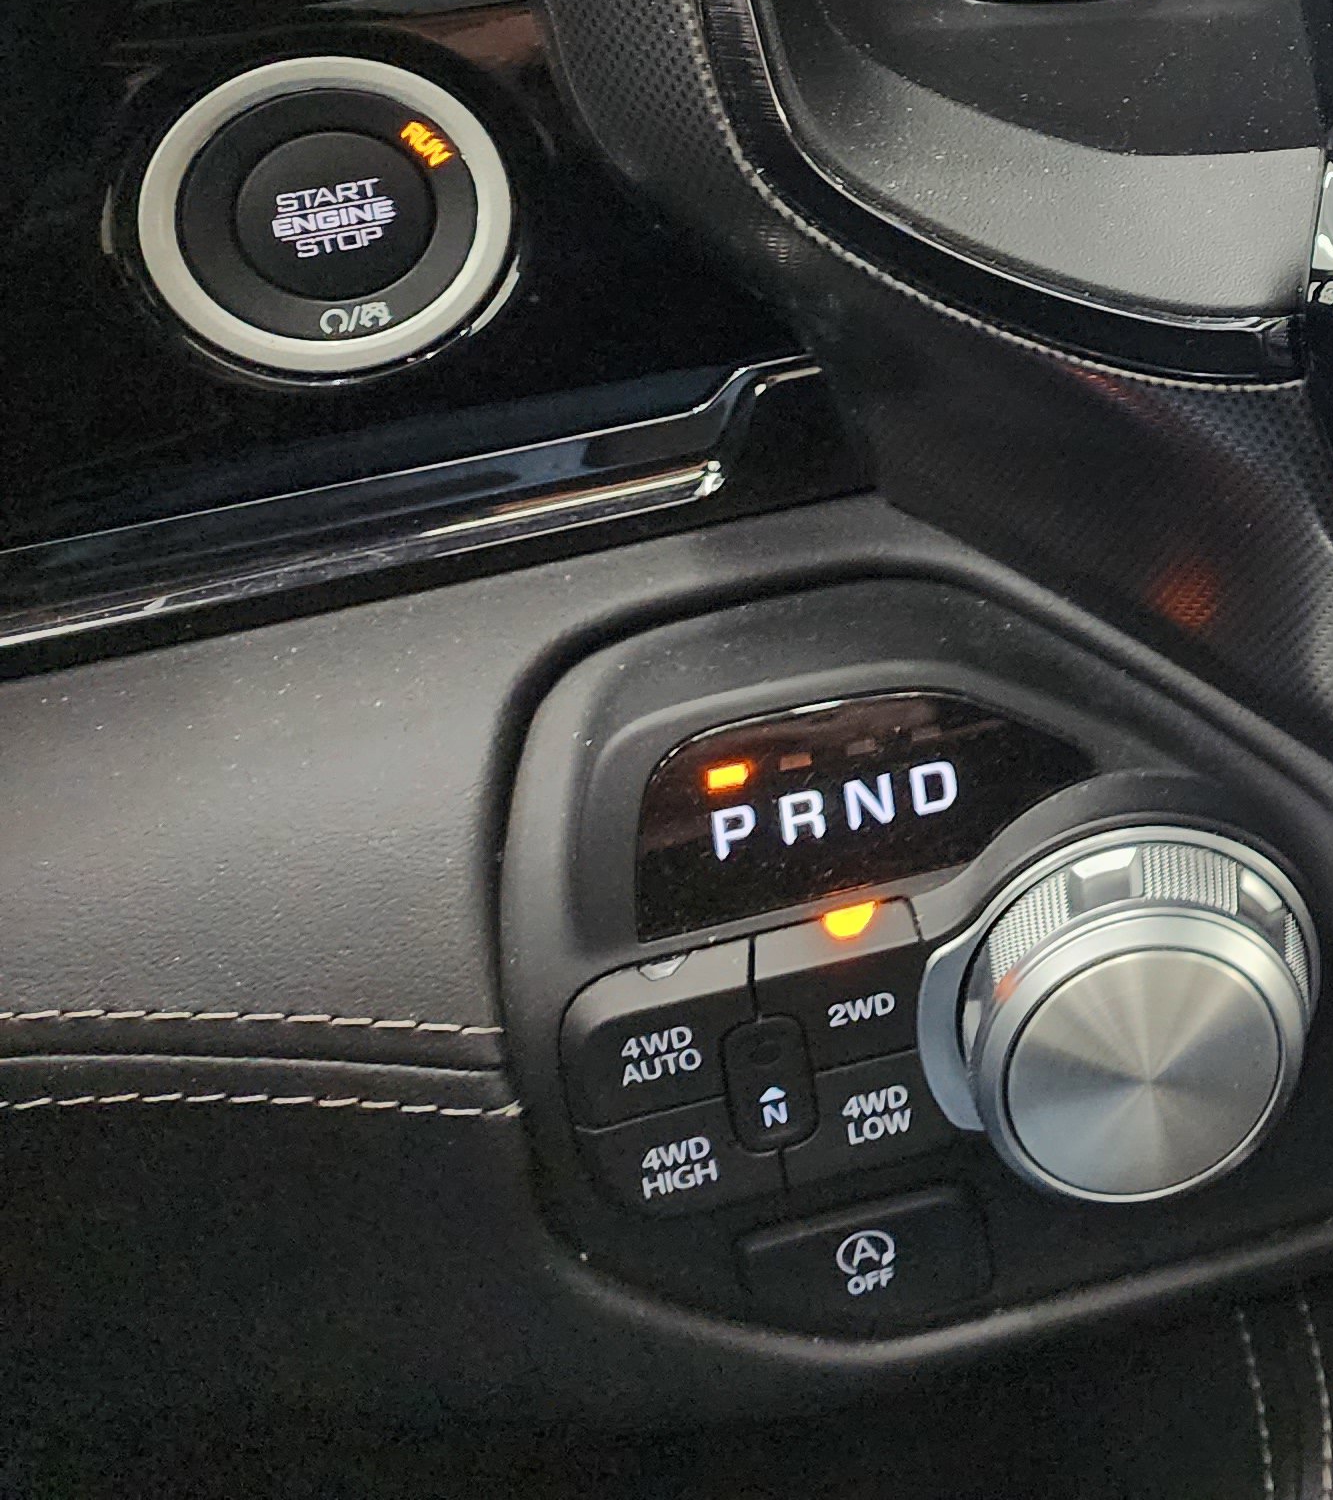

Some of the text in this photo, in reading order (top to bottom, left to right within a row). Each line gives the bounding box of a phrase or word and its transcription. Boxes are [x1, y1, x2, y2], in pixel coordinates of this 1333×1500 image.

[401, 121, 453, 167] RUN
[276, 178, 380, 212] START
[272, 199, 398, 238] ENGINE
[296, 227, 384, 259] STOP
[827, 992, 896, 1028] 2WD
[620, 1025, 694, 1060] 4WD
[621, 1047, 702, 1087] AUTO
[841, 1084, 909, 1120] 4WD
[847, 1106, 912, 1145] LOW
[641, 1135, 712, 1172] 4WD
[641, 1158, 719, 1199] HIGH
[846, 1266, 895, 1296] OFF
